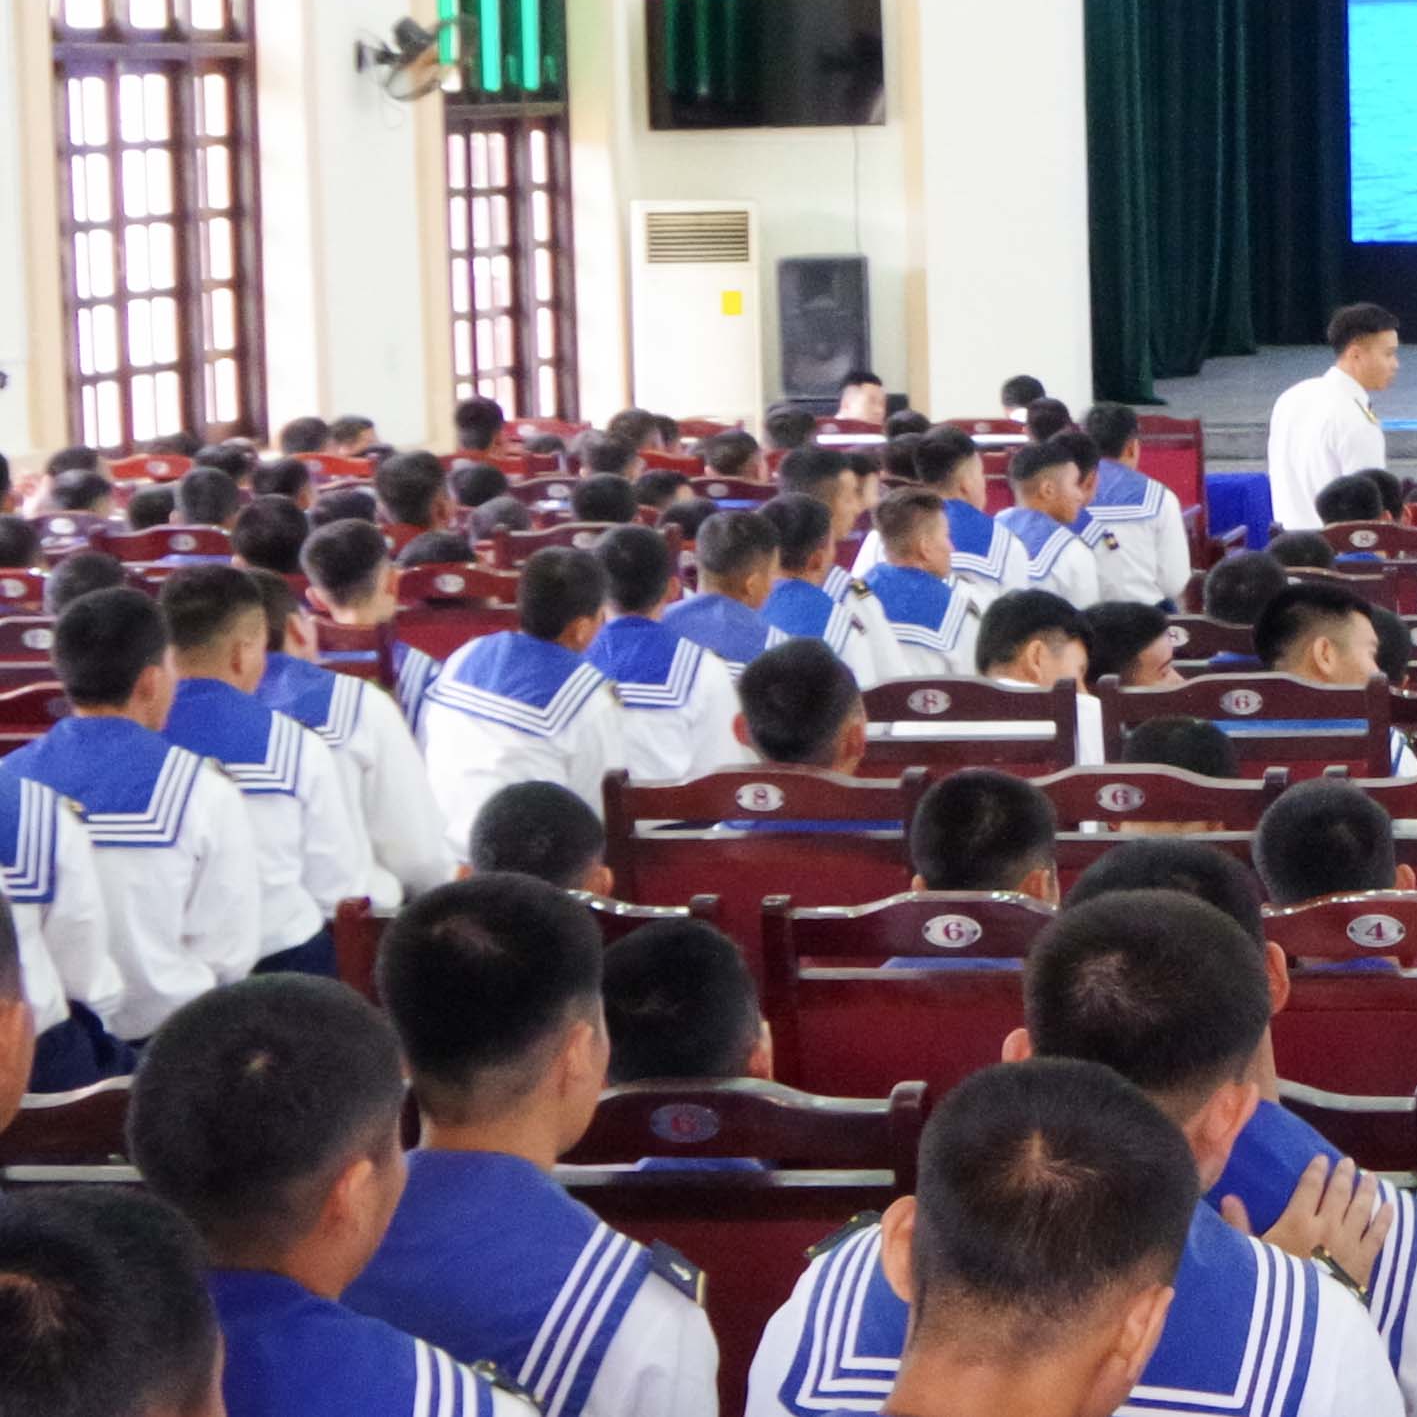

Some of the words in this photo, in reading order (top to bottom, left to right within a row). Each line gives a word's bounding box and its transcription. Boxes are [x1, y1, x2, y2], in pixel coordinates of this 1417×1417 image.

[1234, 695, 1250, 710] 6
[752, 789, 768, 807] 8
[1112, 789, 1130, 807] 6
[942, 921, 964, 941] 6
[1365, 921, 1384, 941] 4
